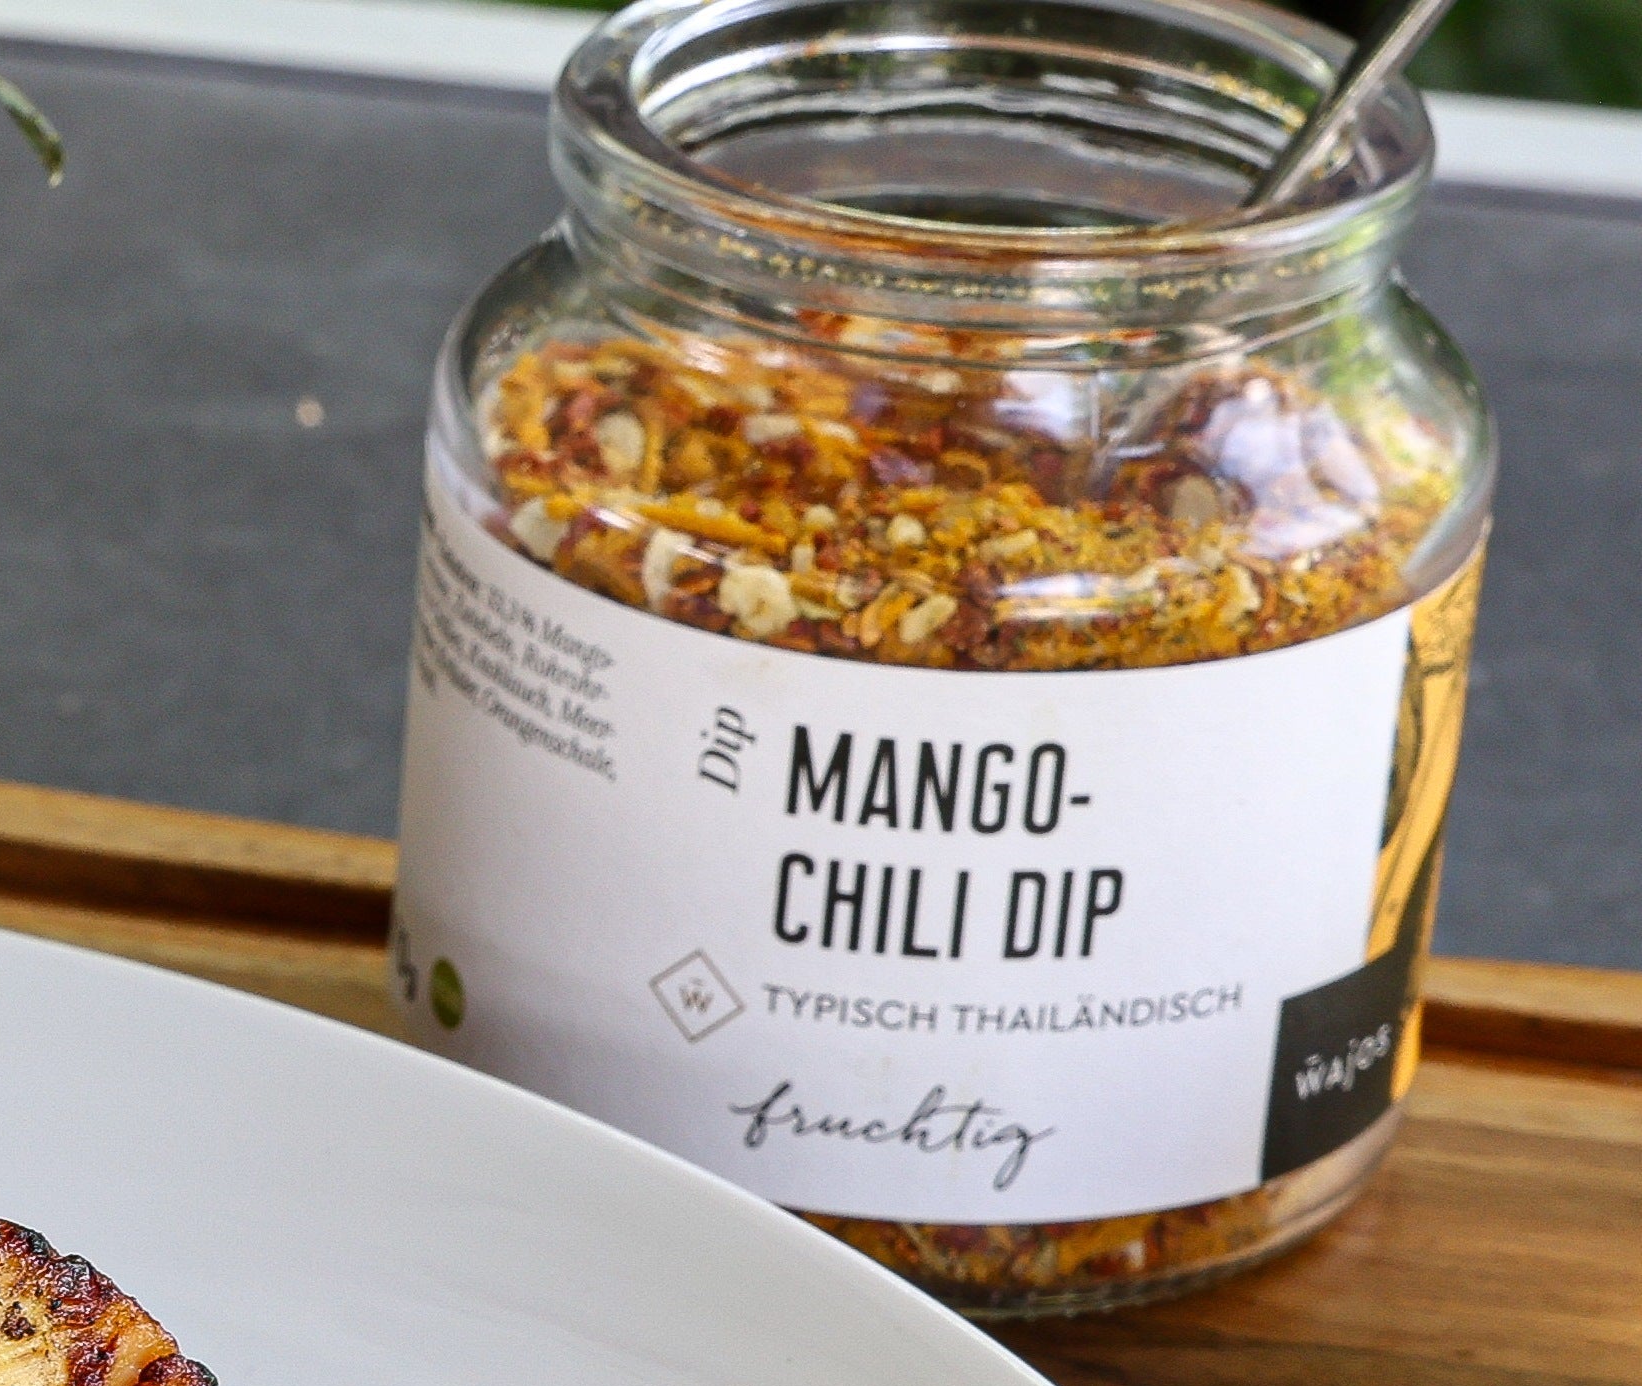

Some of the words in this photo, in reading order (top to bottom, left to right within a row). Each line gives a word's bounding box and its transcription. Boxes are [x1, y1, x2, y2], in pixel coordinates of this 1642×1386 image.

[698, 706, 756, 793] Dip
[785, 725, 1091, 835] MANGO-
[773, 852, 969, 960] CHILI
[1001, 868, 1124, 959] DIP
[762, 983, 937, 1034] TYPISCH
[955, 982, 1244, 1036] THAILÄNDISCH
[728, 1080, 1055, 1192] fruchtig
